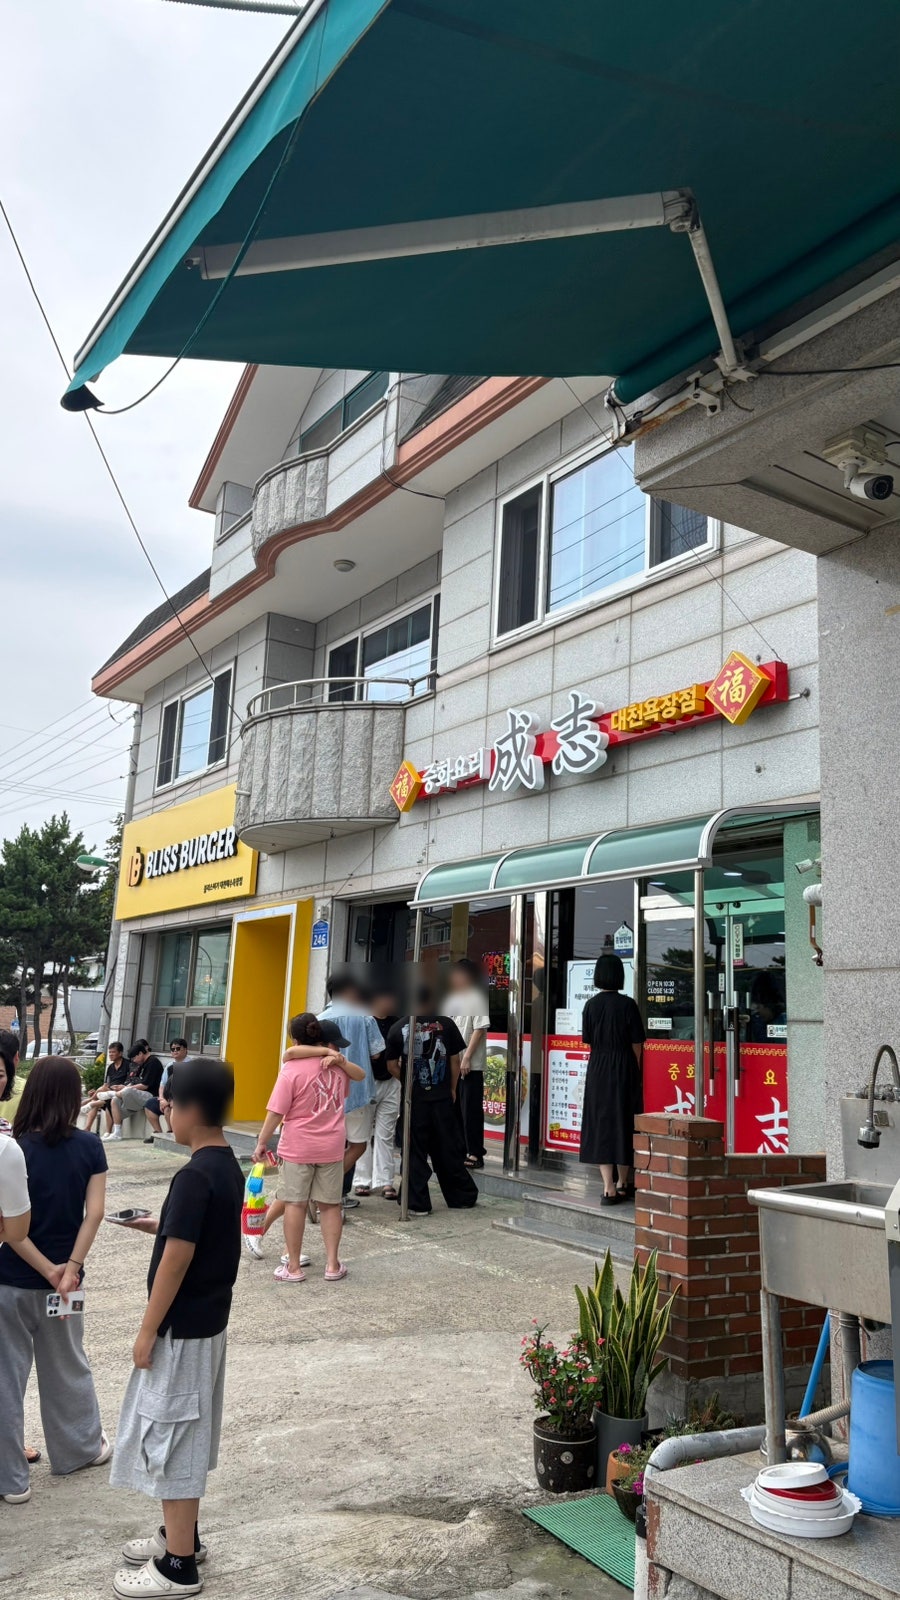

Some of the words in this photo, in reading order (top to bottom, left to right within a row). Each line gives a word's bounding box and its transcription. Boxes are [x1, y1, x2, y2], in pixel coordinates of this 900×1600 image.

[395, 773, 409, 798] 福
[422, 748, 487, 793] 중화요리
[611, 684, 698, 732] 대천욕장점
[718, 670, 747, 706] 福
[145, 843, 178, 881] BLISS
[177, 825, 237, 869] BURGER
[313, 934, 326, 946] 246
